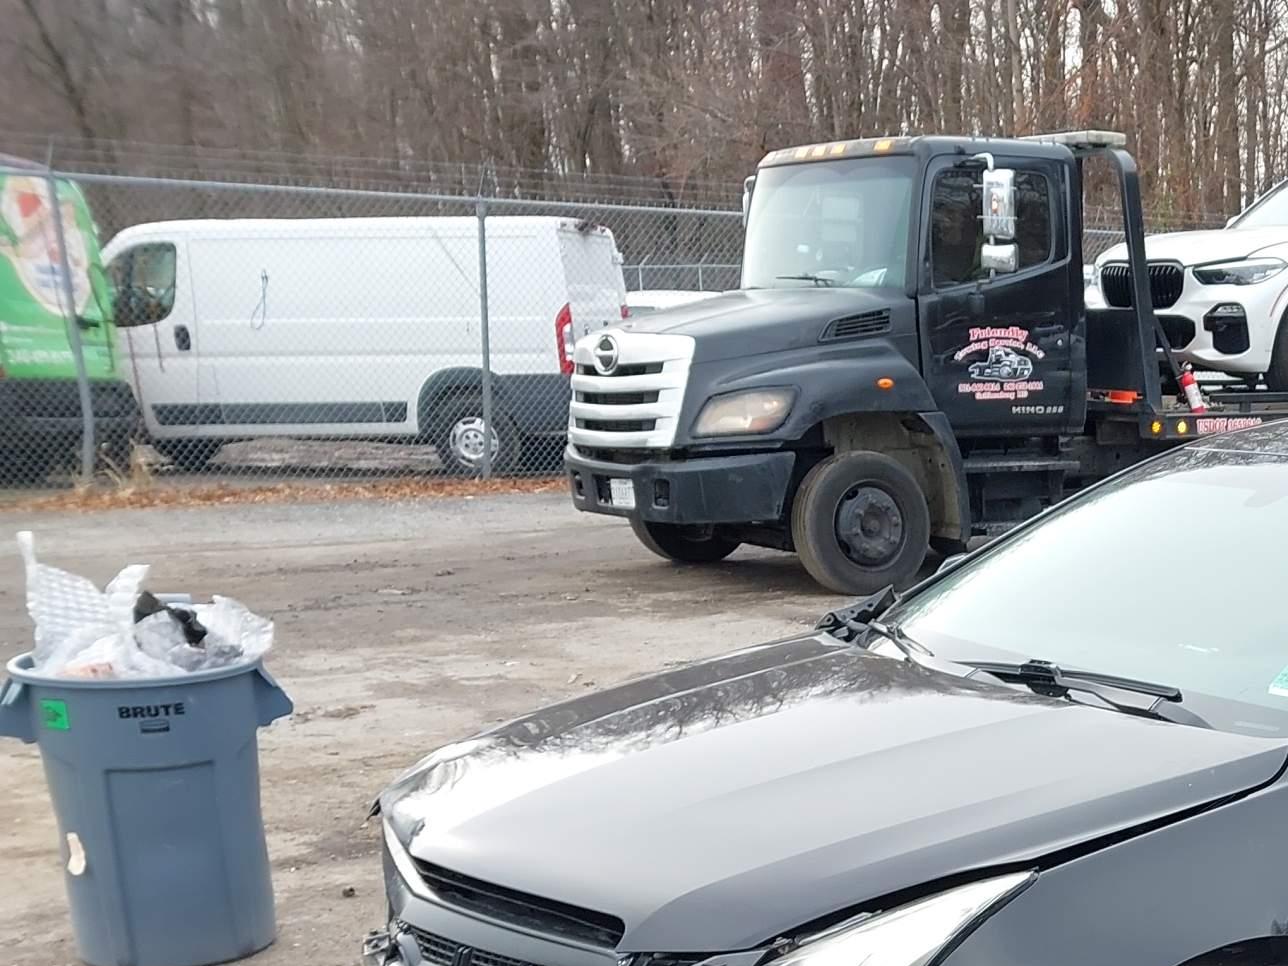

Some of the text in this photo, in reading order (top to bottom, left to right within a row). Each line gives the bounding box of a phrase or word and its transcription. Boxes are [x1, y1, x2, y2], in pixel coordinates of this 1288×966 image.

[968, 326, 1029, 342] Friendly
[1011, 405, 1045, 414] HINO
[117, 702, 186, 719] BRUTE
